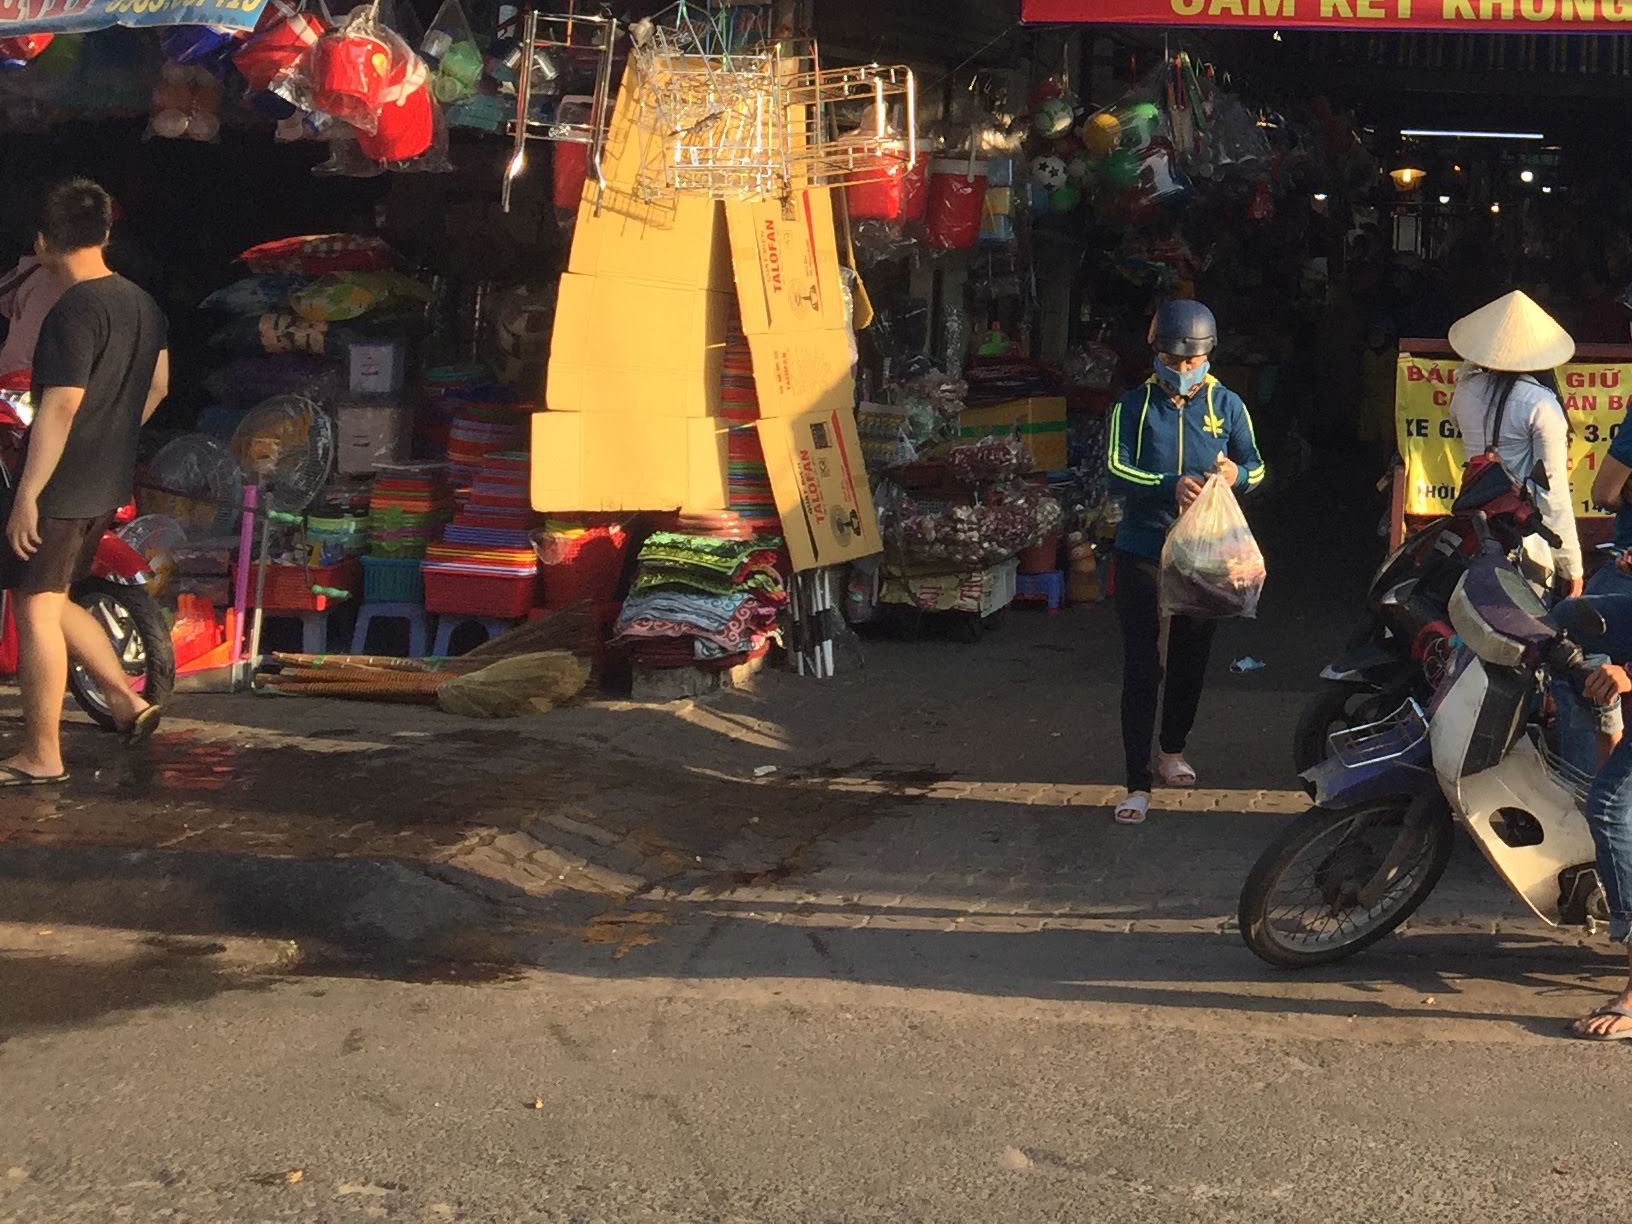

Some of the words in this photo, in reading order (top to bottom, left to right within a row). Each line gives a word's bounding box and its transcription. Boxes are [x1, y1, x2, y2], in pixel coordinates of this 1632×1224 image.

[765, 219, 783, 293] TALOFAN
[1564, 392, 1597, 410] ĂN
[1566, 368, 1621, 388] GIỮ
[799, 449, 825, 525] TALOFAN
